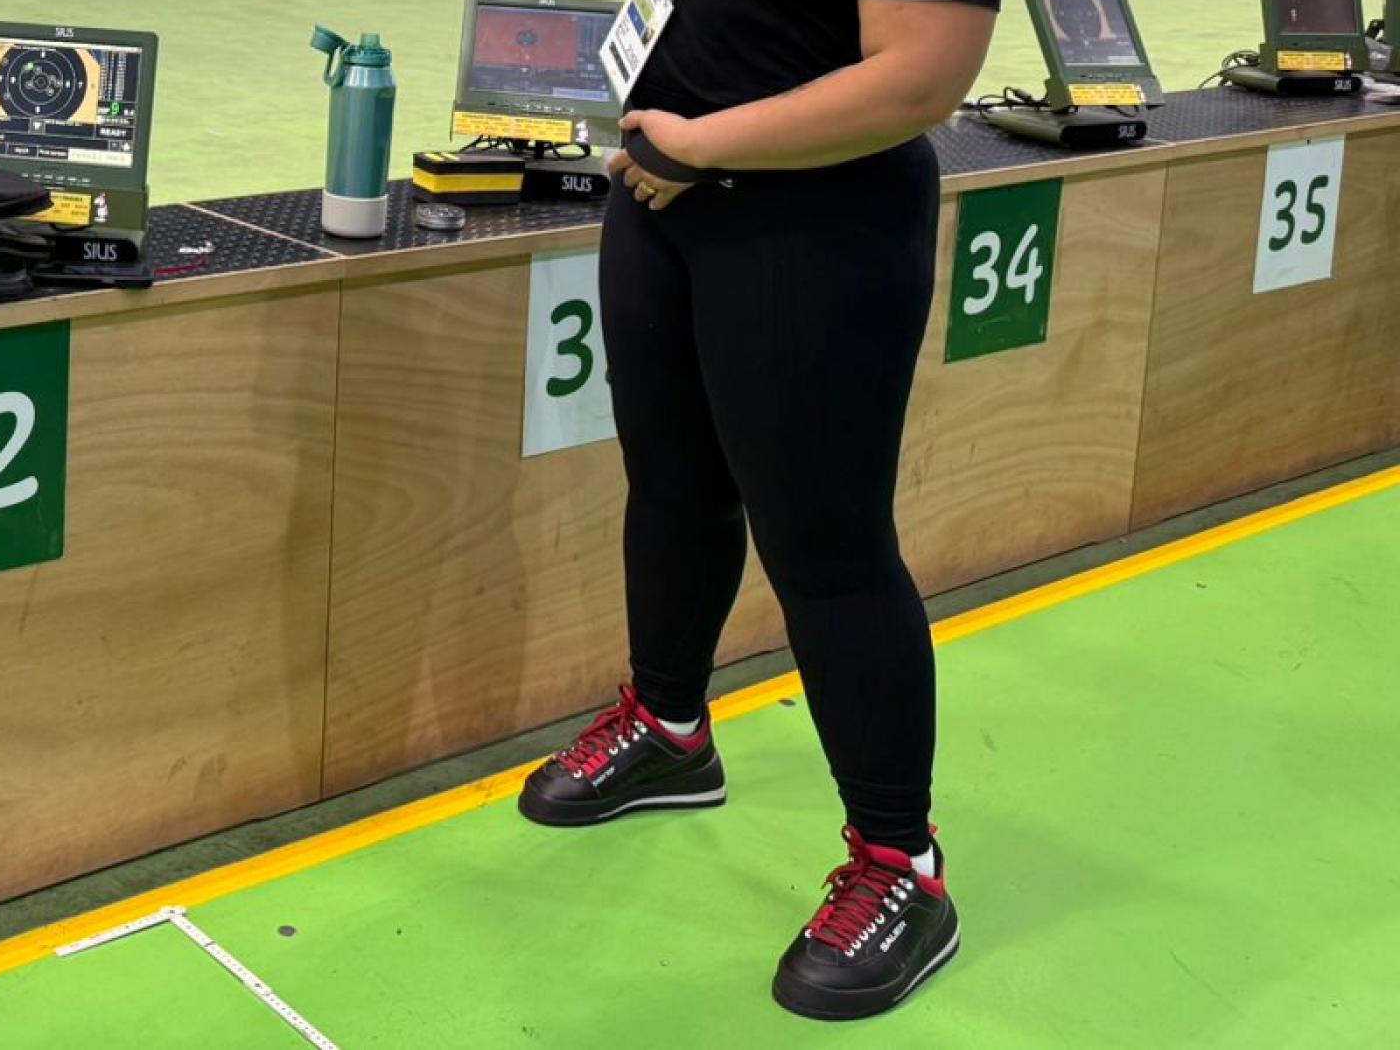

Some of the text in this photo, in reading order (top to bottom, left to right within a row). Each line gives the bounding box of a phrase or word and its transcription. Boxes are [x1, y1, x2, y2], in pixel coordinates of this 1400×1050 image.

[1268, 174, 1329, 252] 35
[963, 223, 1044, 316] 34
[545, 298, 612, 398] 3
